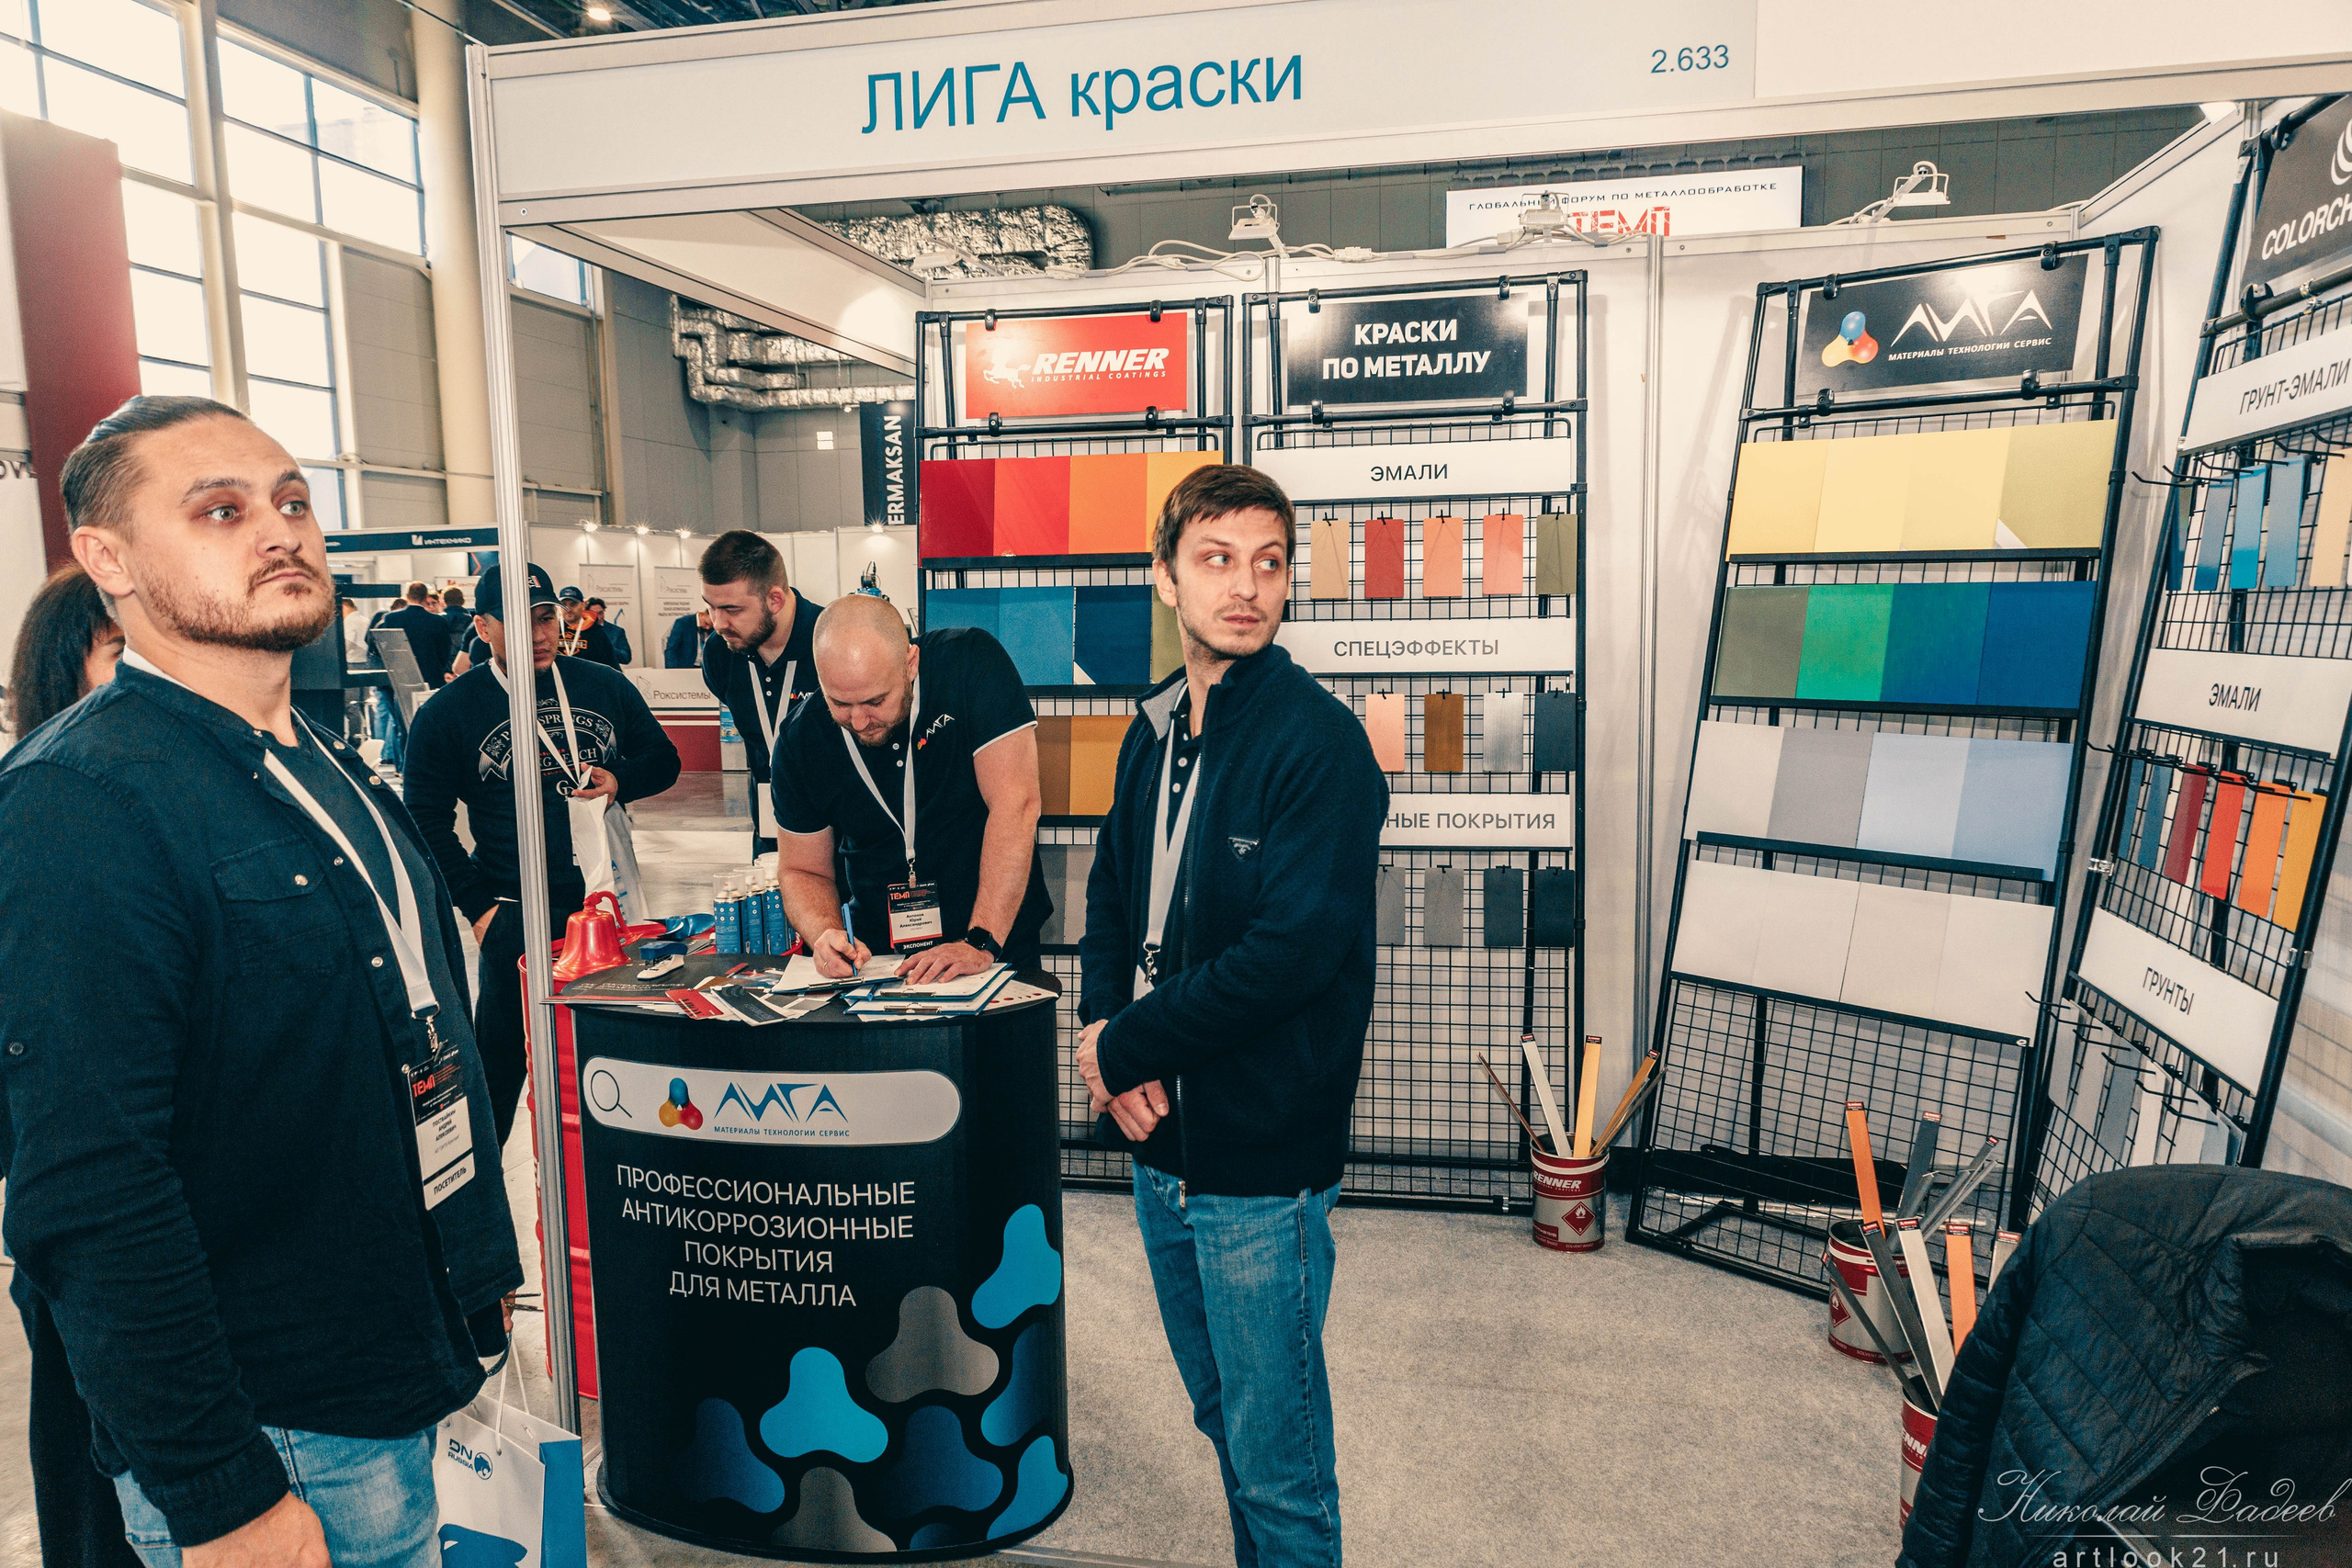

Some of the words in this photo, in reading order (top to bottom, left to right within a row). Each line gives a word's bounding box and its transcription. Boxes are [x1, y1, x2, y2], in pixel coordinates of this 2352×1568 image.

[1651, 44, 1730, 73] 2.633
[862, 62, 1046, 134] ЛИГА
[1070, 54, 1302, 130] краски
[1469, 197, 1555, 210] ГЛОБАЛЬНЙ
[1561, 194, 1606, 205] ФОРУМ
[1611, 193, 1629, 201] ПО
[1634, 183, 1778, 199] МЕТАЛЛООБРАБОТКЕ
[1569, 206, 1671, 236] ТЕМП
[1354, 319, 1458, 346] КРАСКИ
[1032, 347, 1170, 375] RENNER
[1888, 349, 1945, 362] МАТЕРИАЛЫ
[1948, 342, 2010, 355] ТЕХНОЛОГИИ
[2014, 337, 2052, 348] СЕРВИС
[1031, 373, 1102, 383] INDUSTRIAL
[1108, 370, 1167, 379] COATINGS
[1322, 358, 1360, 380] ПО
[1364, 351, 1492, 378] МЕТАЛЛУ
[2239, 358, 2351, 415] ГРУНТ-ЭМАЛИ
[884, 415, 905, 525] ERMAKSAN
[1371, 464, 1449, 482] ЭМАЛИ
[1334, 639, 1499, 659] СПЕЦЭФФЕКТЫ
[653, 690, 711, 701] Роксистемы
[2208, 682, 2262, 713] ЭМАЛИ
[1437, 812, 1556, 829] ПОКРЫТИЯ
[903, 941, 933, 950] ЭКСПОНЕНТ
[2142, 965, 2196, 1016] ГРУНТЫ
[714, 1082, 849, 1122] ЛИГА
[714, 1126, 761, 1135] МАТЕРИАЛЫ
[763, 1128, 816, 1137] ТЕХНОЛОГИИ
[434, 1167, 468, 1195] ПОСЕТИТЕЛЬ
[616, 1164, 916, 1207] ПРОФЕССИОНАЛЬНЫЕ
[1533, 1170, 1582, 1190] RENNER
[622, 1198, 914, 1239] АНТИКОРРОЗИОННЫЕ
[684, 1241, 833, 1273] ПОКРЫТИЯ
[669, 1270, 720, 1298] ДЛЯ
[728, 1278, 857, 1306] МЕТАЛЛА
